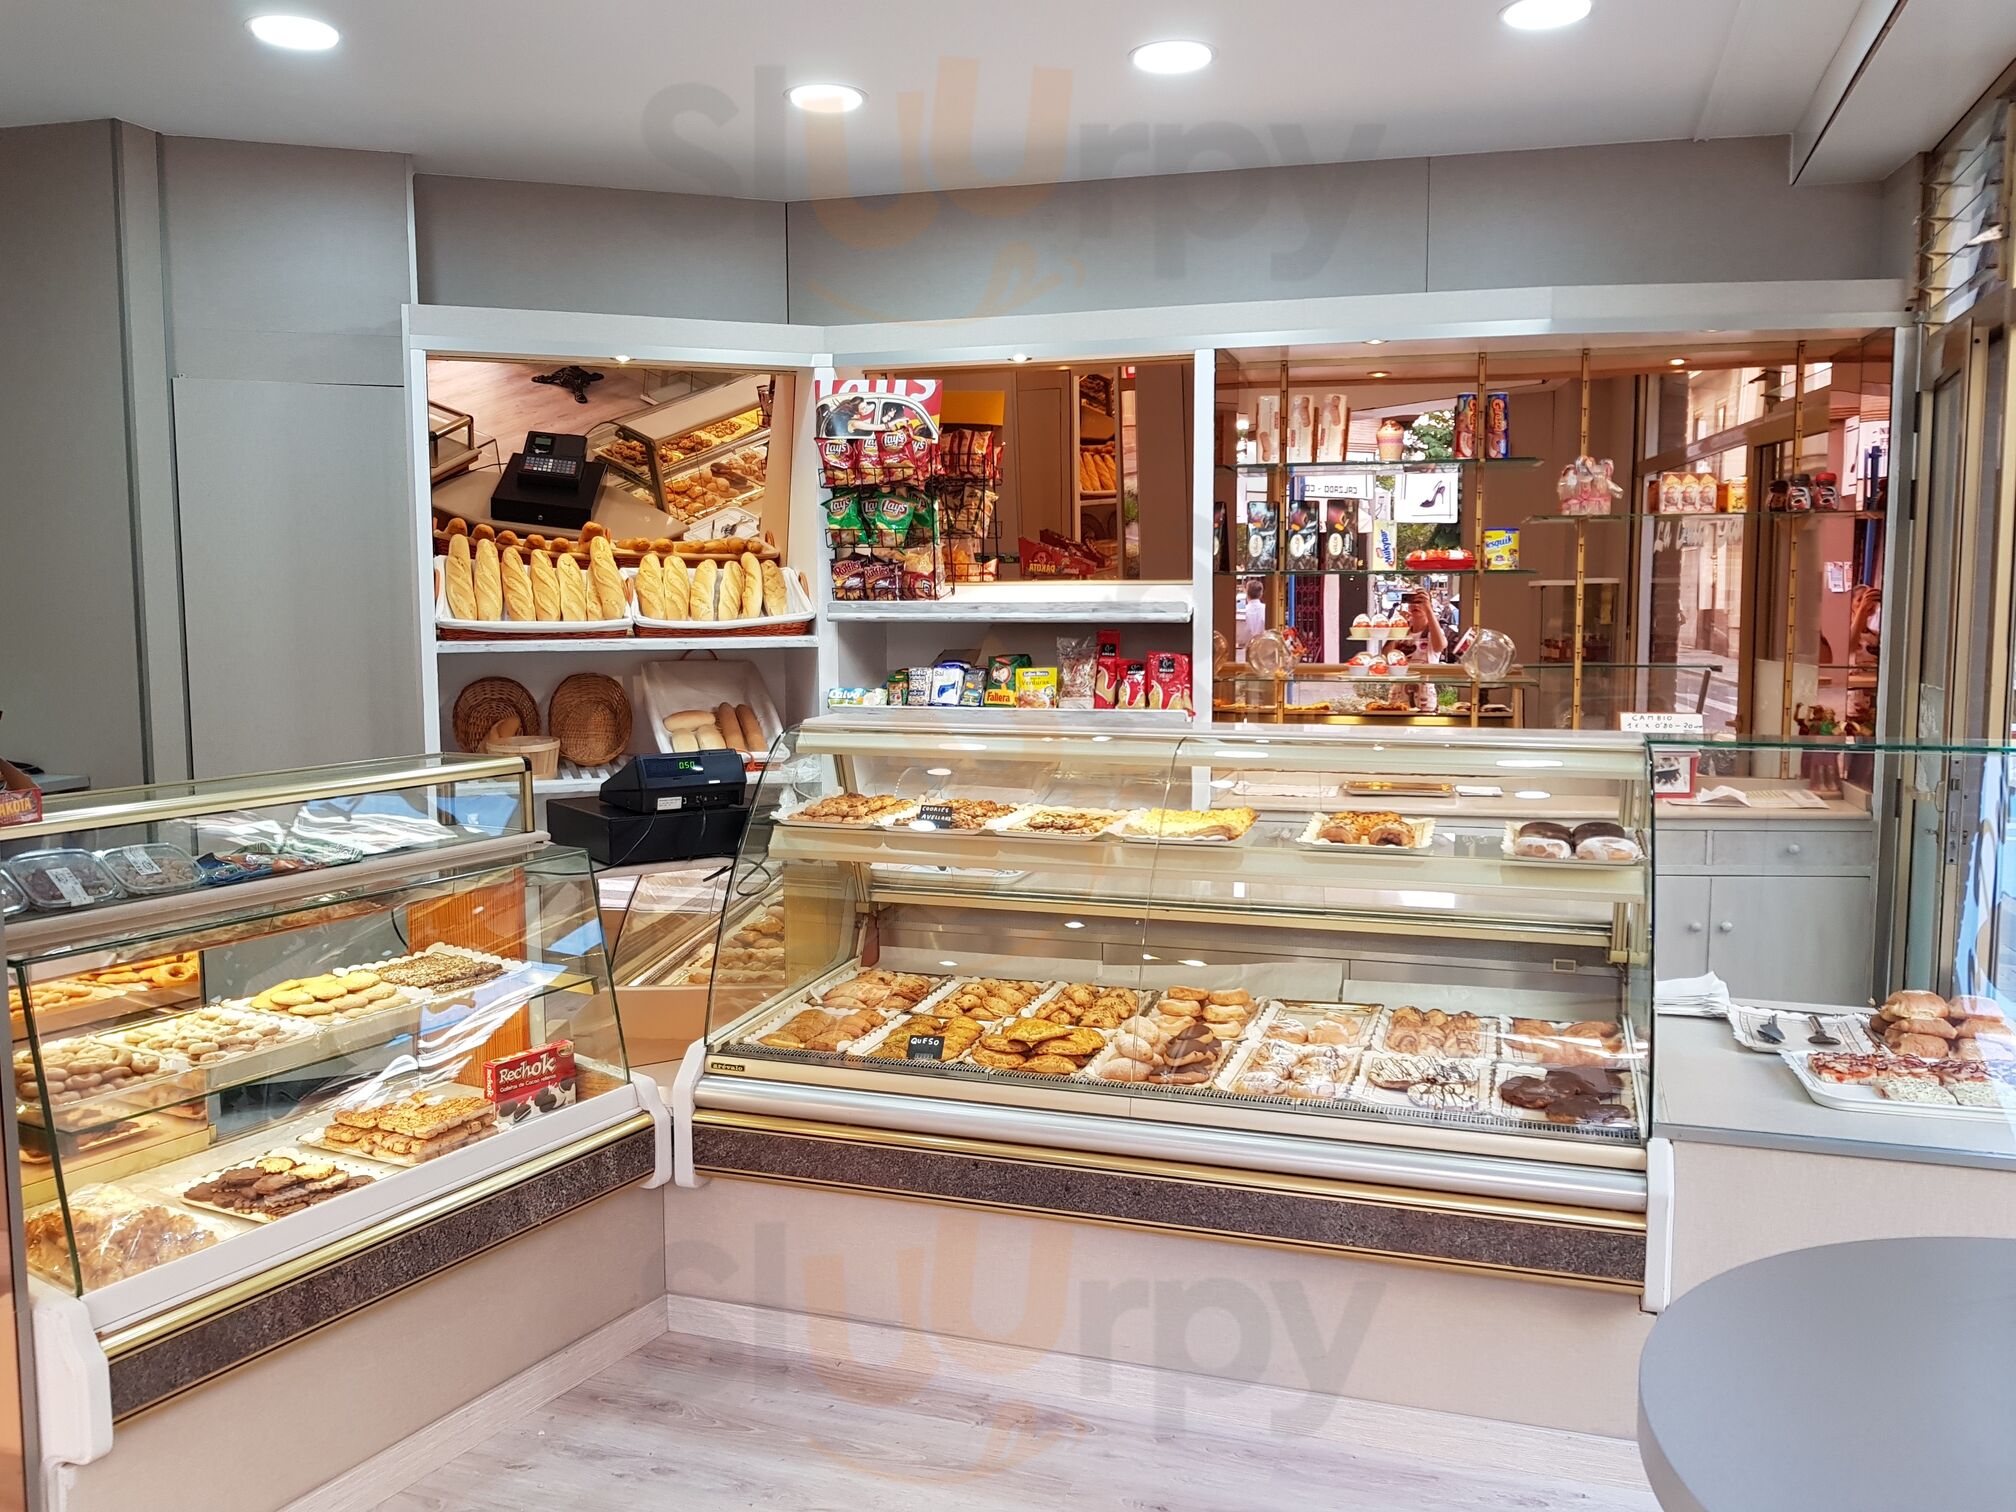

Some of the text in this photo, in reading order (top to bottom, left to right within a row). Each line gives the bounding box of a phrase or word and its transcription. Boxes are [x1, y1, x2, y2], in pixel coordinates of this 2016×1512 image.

[1485, 534, 1513, 549] esquik
[834, 561, 861, 576] Ruffles
[829, 690, 861, 698] Calvo
[986, 692, 1010, 702] Fallera
[911, 1037, 940, 1046] QUESO
[499, 1052, 557, 1084] Rechok
